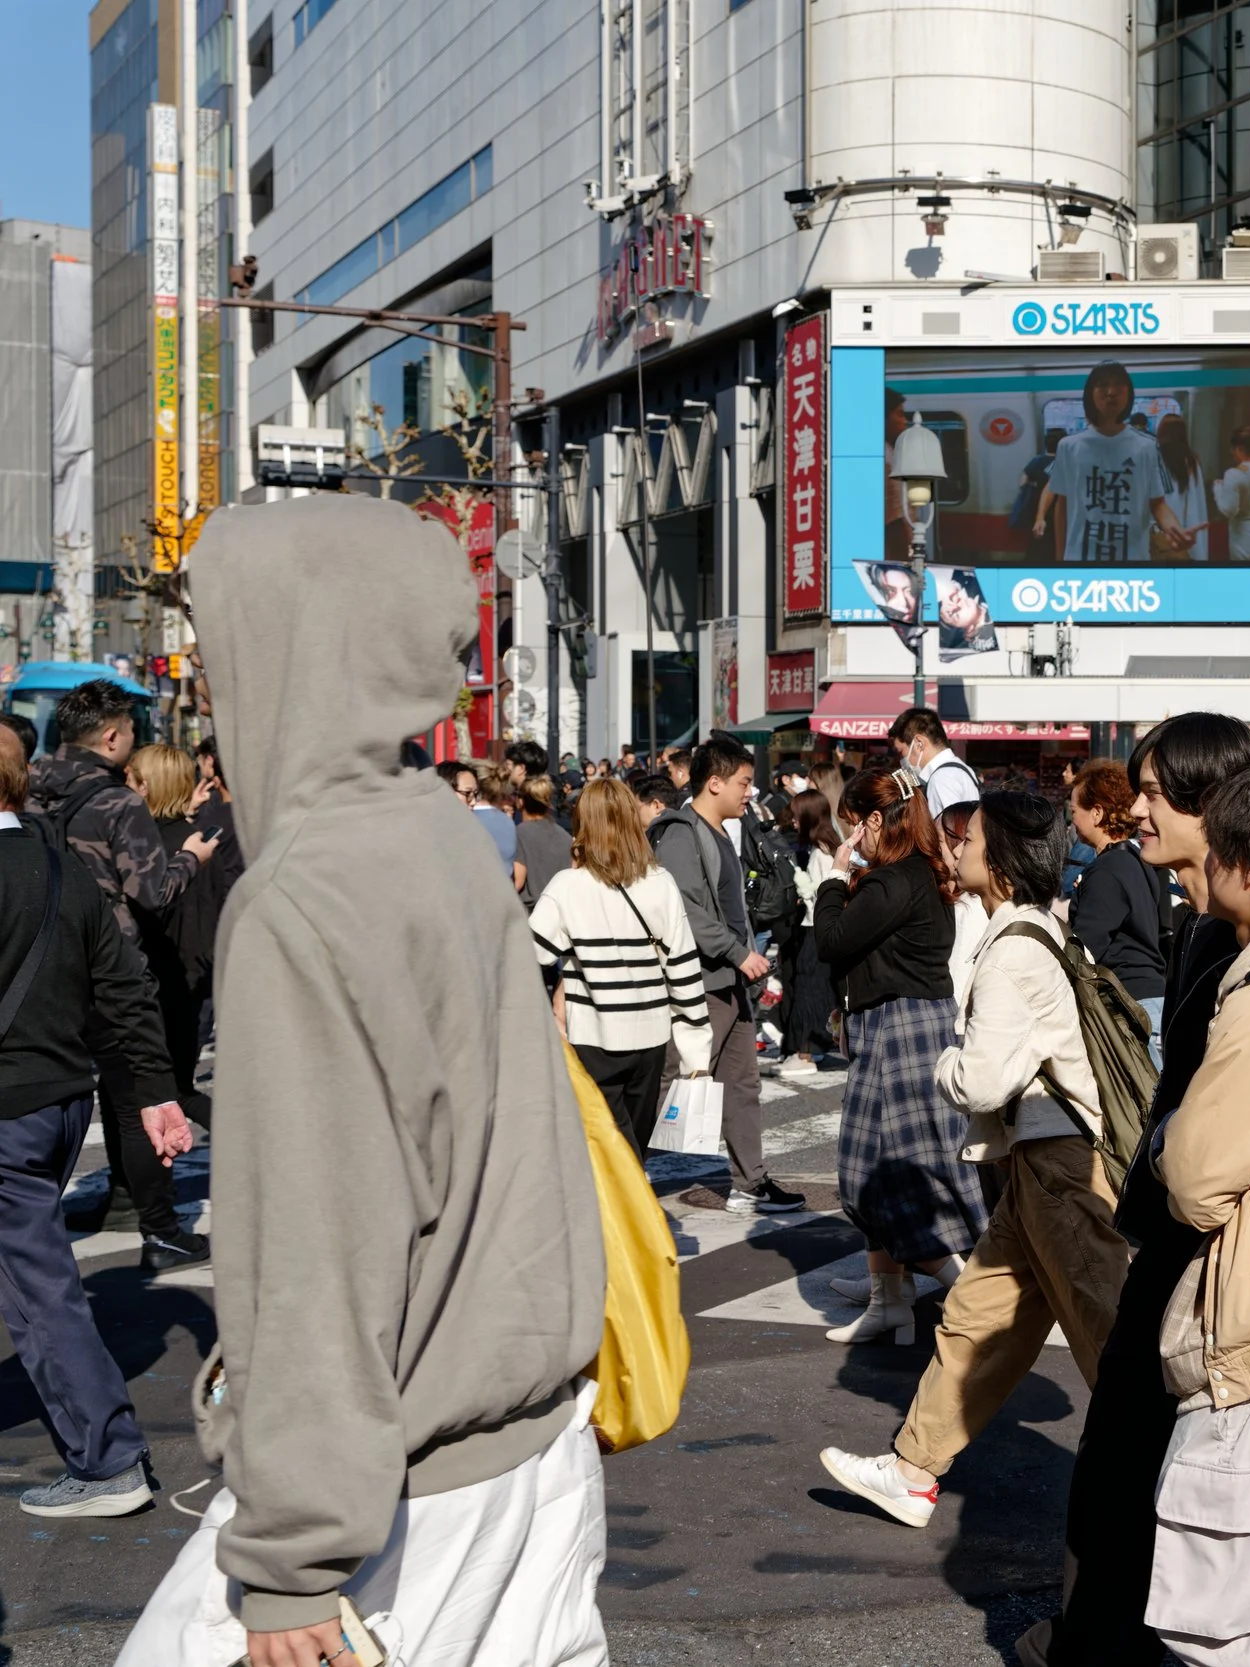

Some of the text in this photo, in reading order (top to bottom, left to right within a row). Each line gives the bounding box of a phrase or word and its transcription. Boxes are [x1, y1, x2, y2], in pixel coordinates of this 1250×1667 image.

[598, 212, 706, 339] MAGNET
[161, 439, 175, 506] TOUCH
[792, 371, 816, 590] 天津甘栗
[769, 667, 814, 695] 天津甘栗
